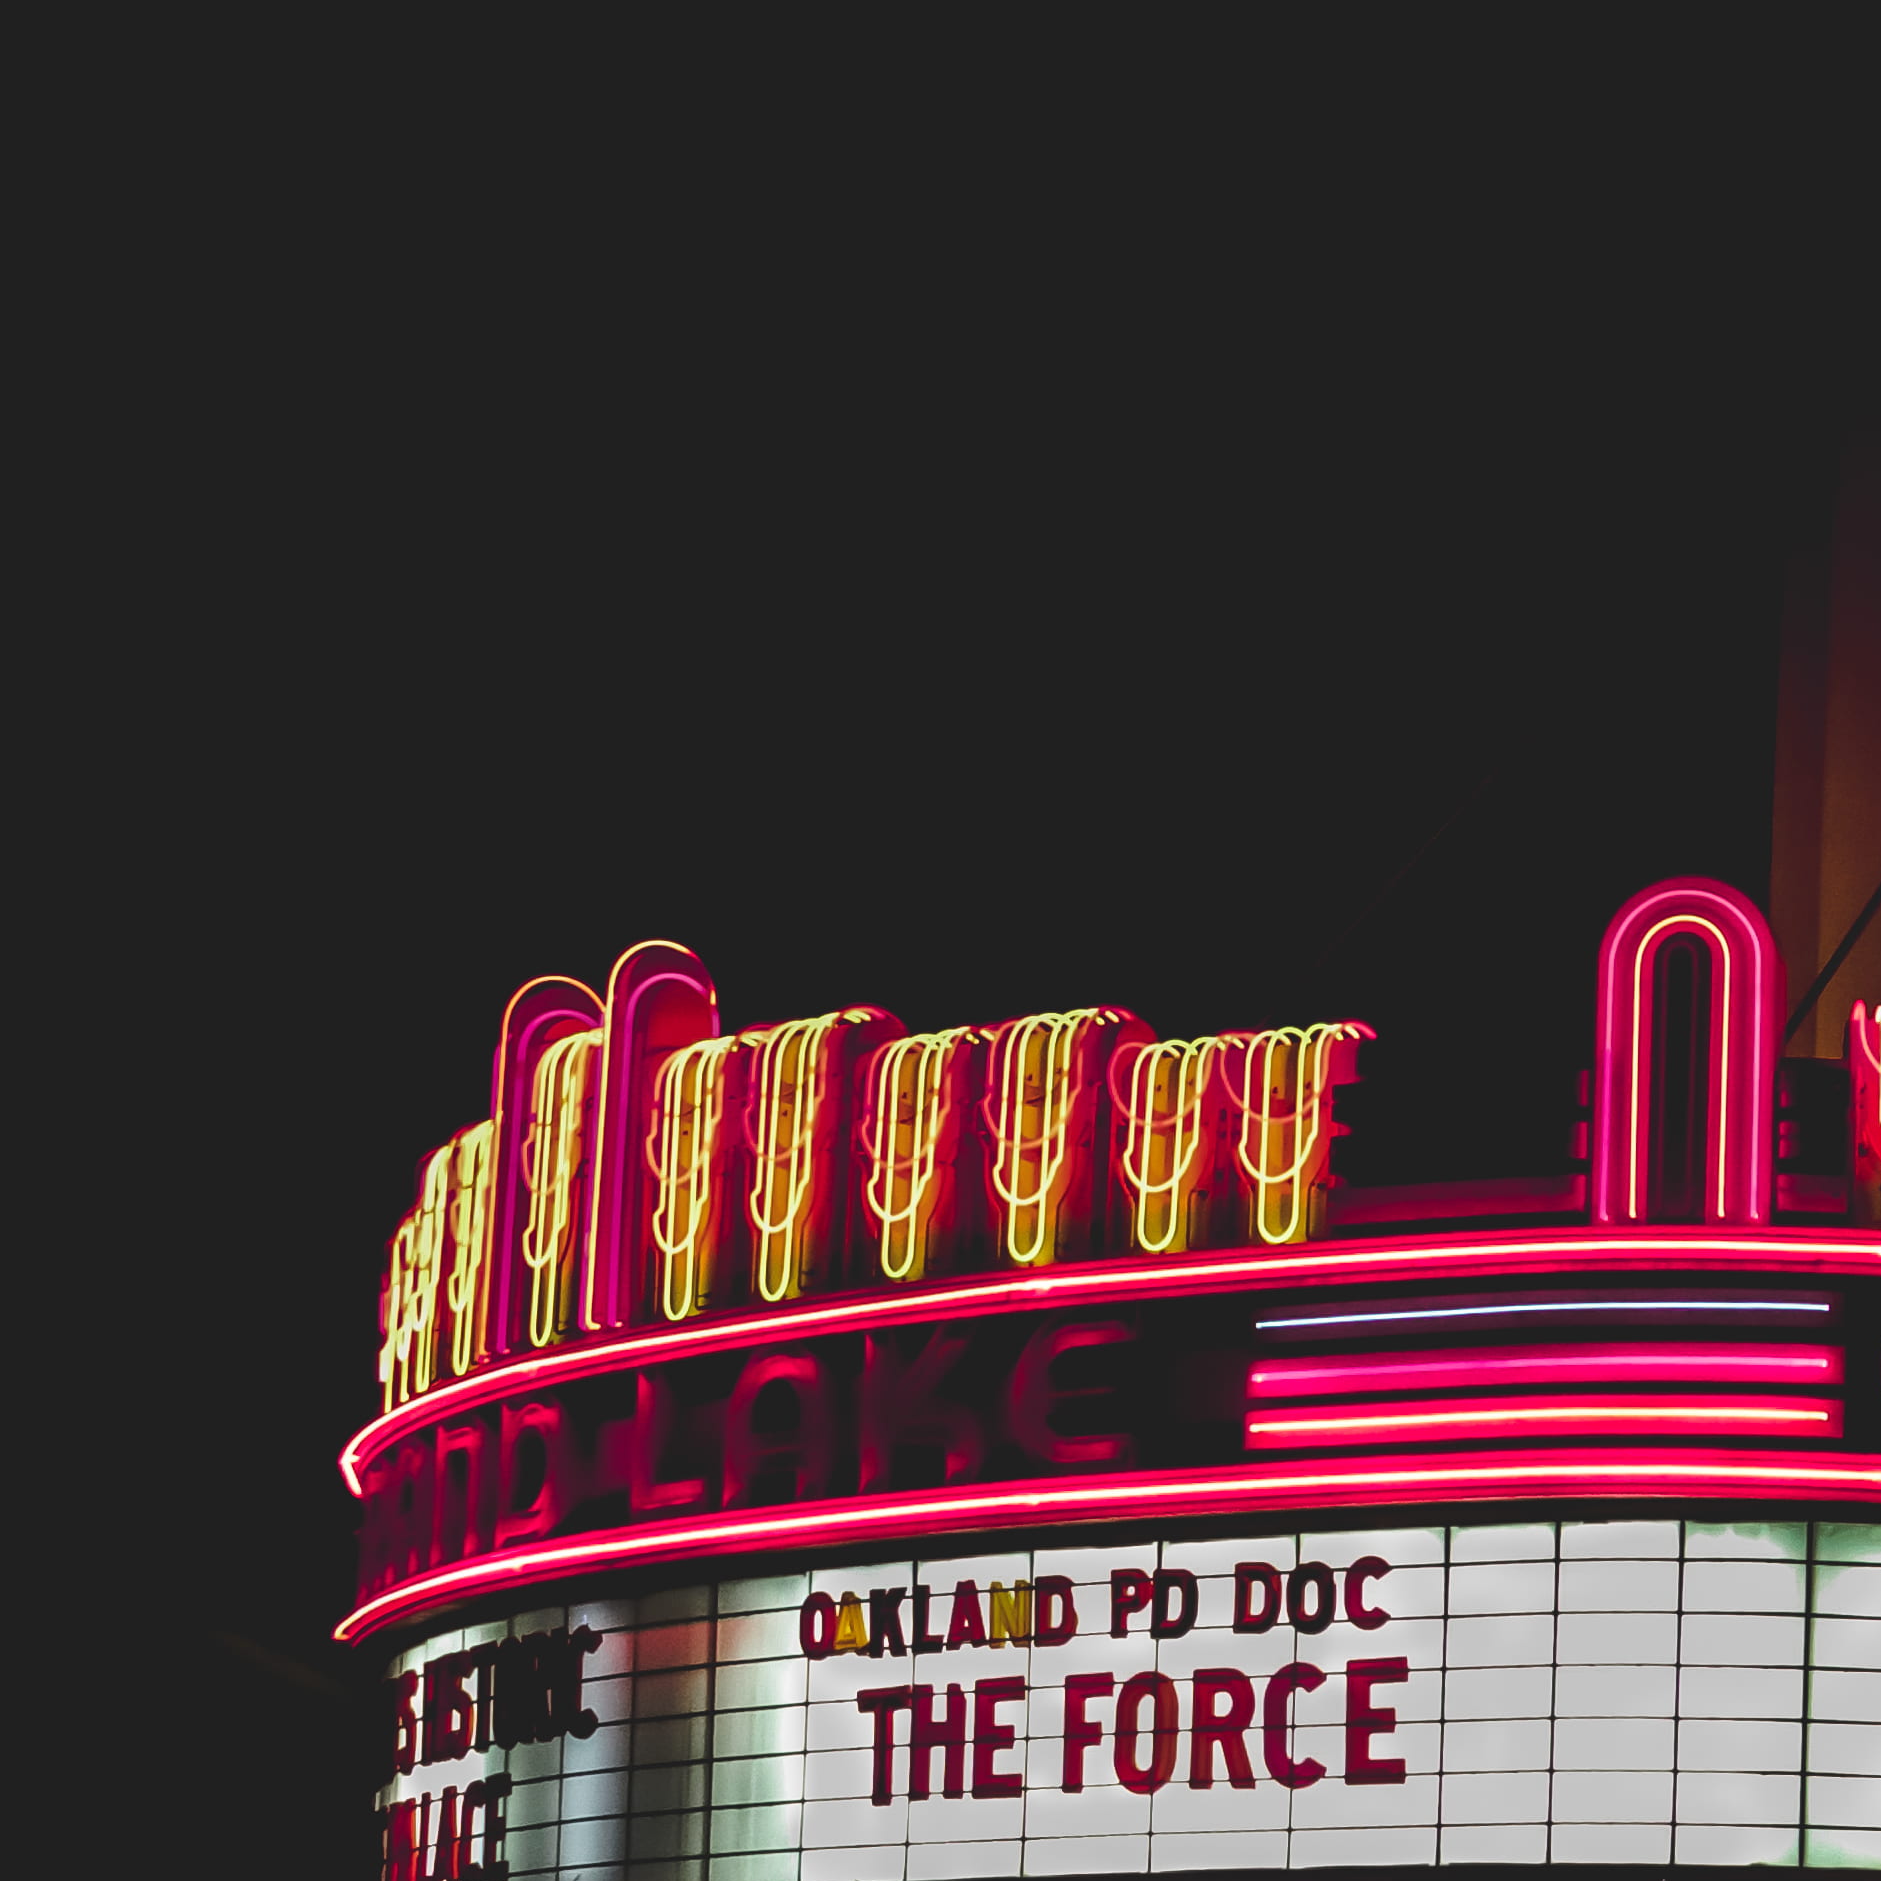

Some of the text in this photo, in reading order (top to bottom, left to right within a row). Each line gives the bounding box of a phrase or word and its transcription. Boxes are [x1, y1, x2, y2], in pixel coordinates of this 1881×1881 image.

[628, 1309, 1140, 1516] LAKE
[799, 1555, 1393, 1660] OAKLAND PD DOC
[857, 1656, 1409, 1806] THE FORCE
